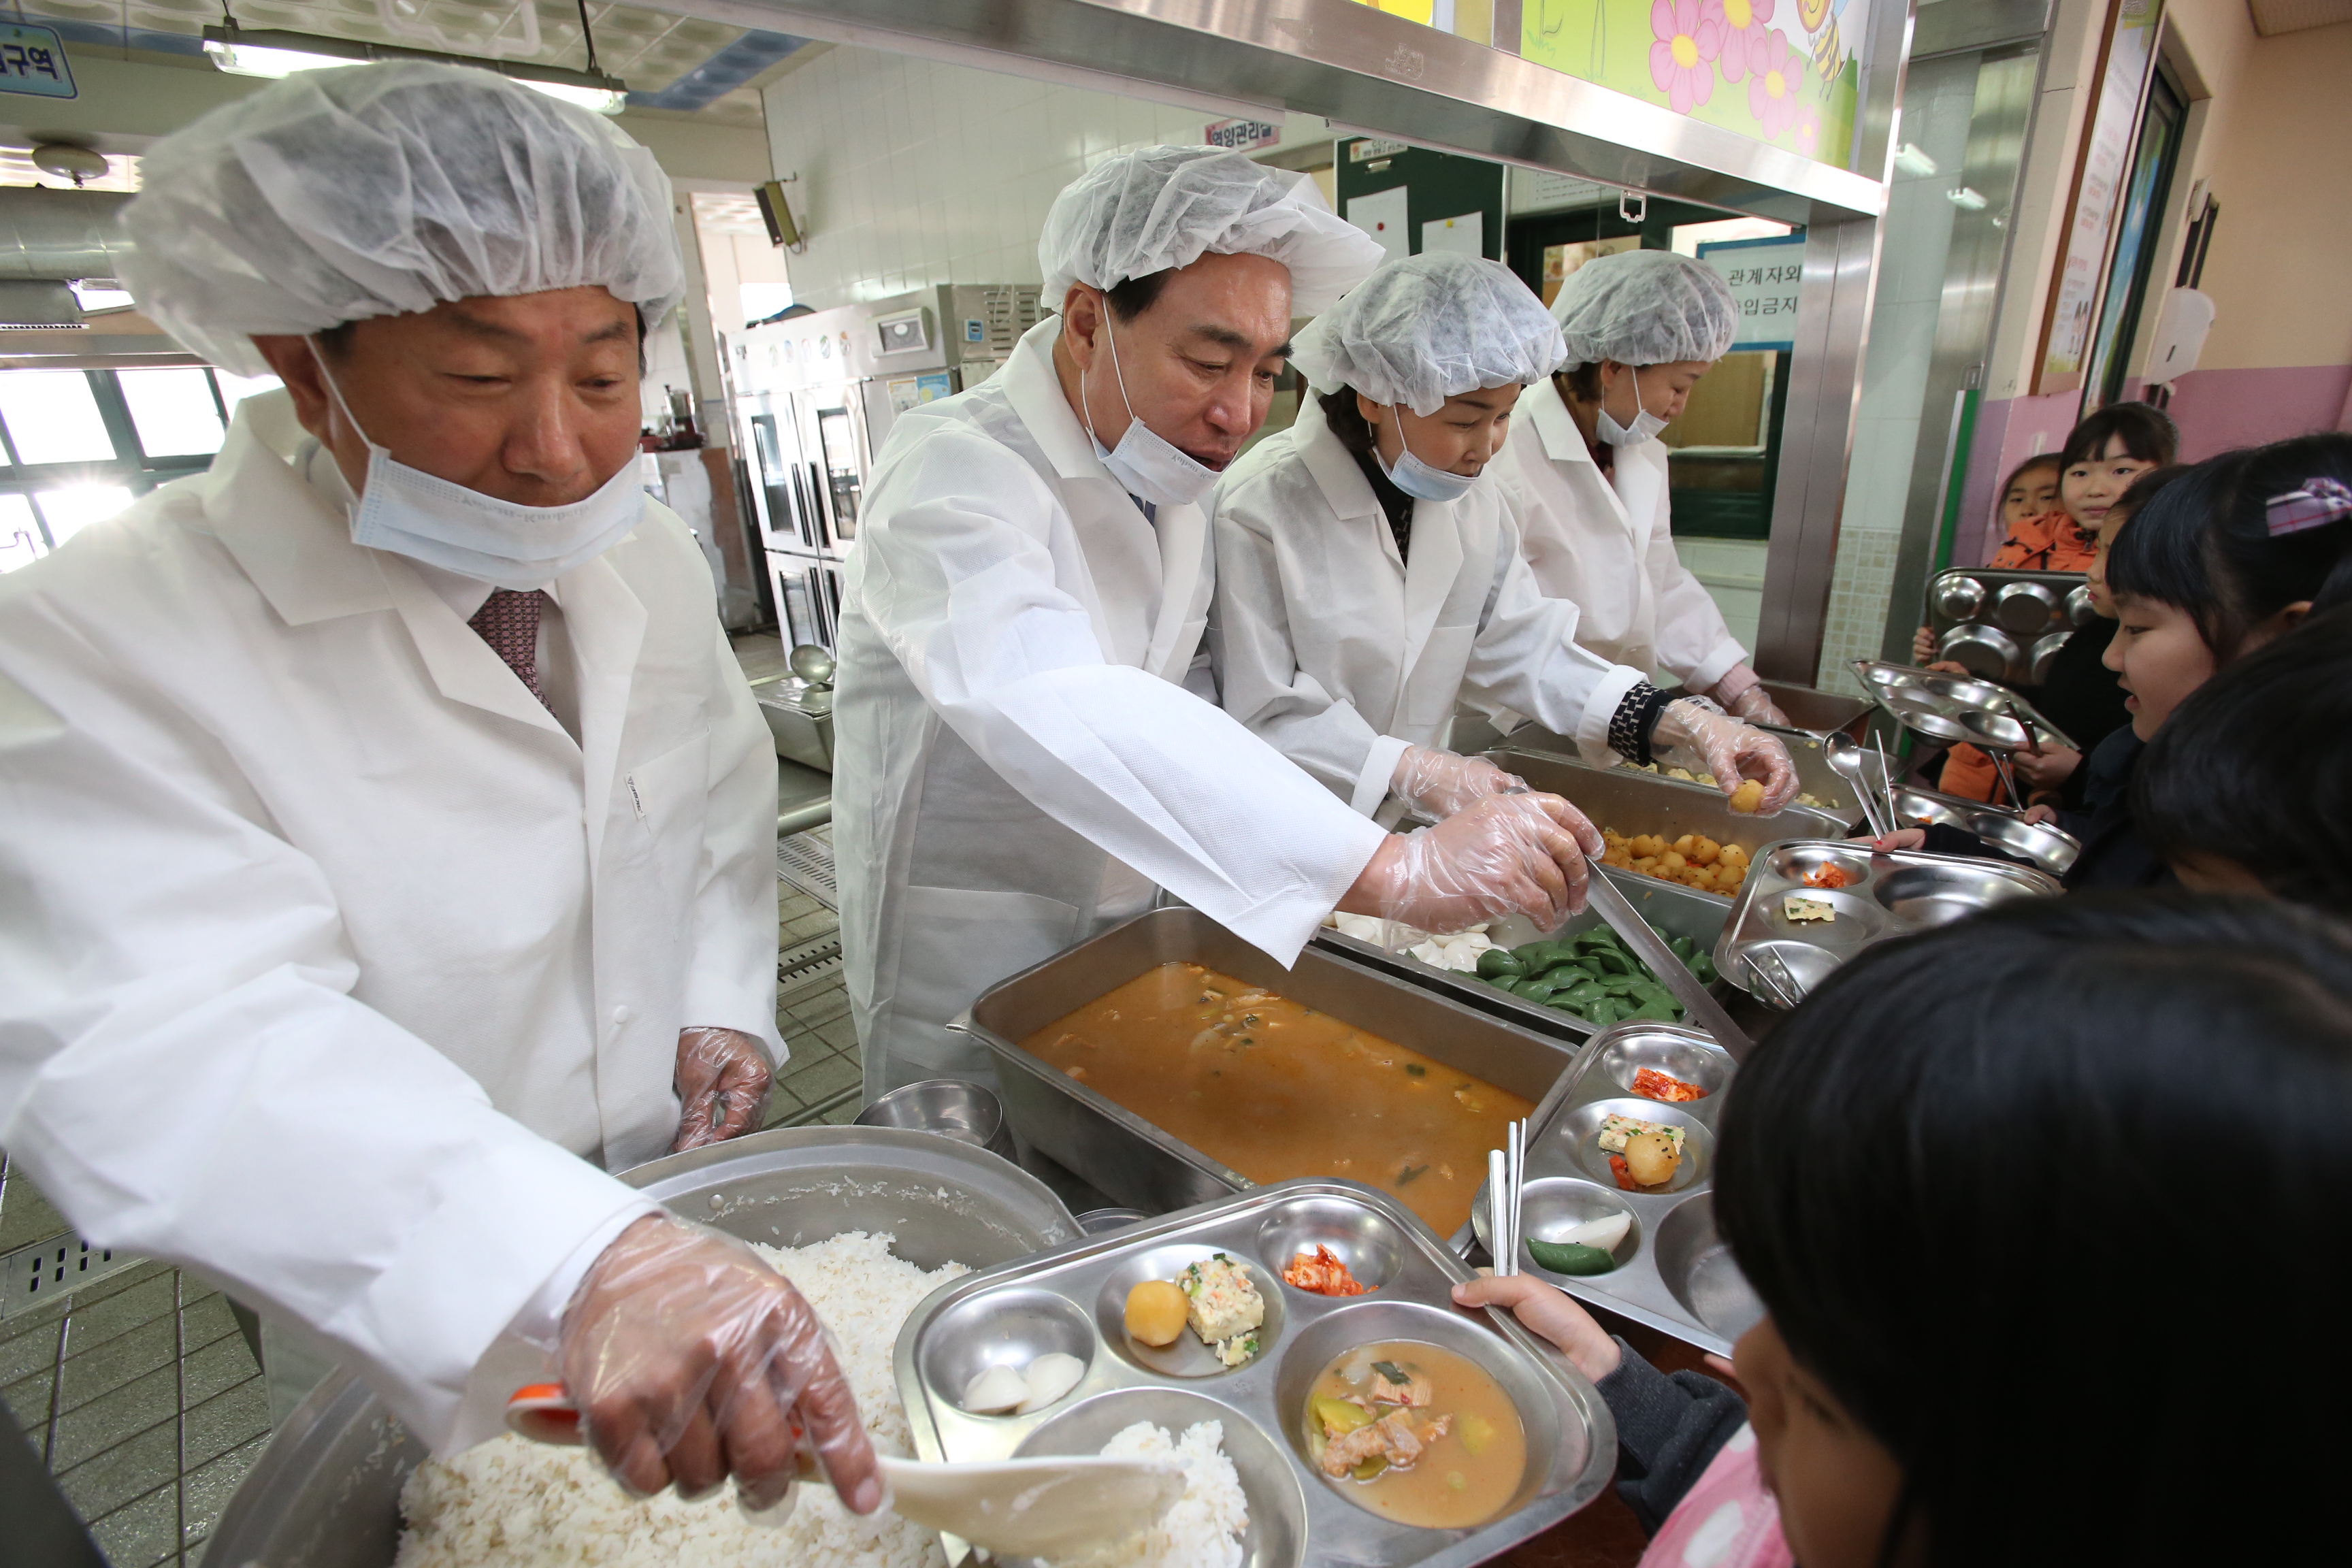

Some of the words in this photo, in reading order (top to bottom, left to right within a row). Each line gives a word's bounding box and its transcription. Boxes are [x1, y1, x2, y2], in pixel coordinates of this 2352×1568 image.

[0, 44, 59, 80] 구역
[1728, 264, 1803, 287] 관계자외
[1737, 295, 1798, 316] 입금지
